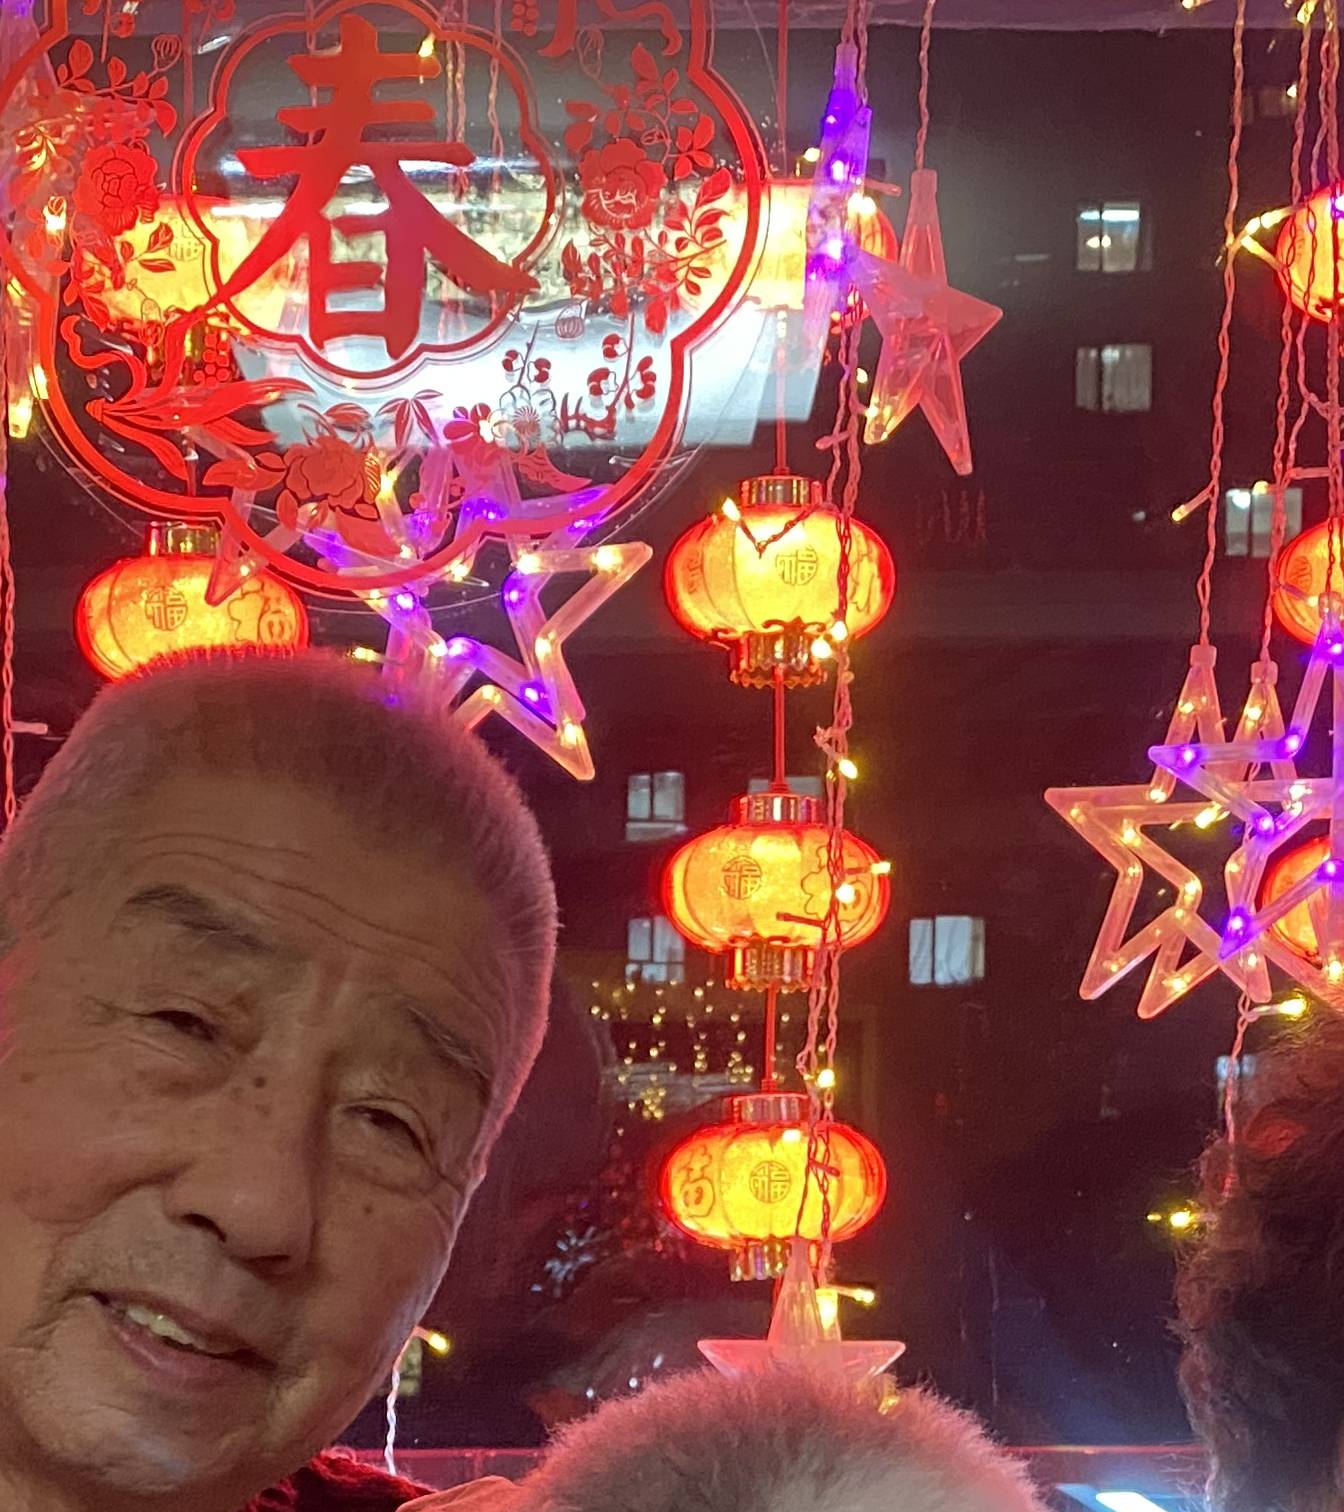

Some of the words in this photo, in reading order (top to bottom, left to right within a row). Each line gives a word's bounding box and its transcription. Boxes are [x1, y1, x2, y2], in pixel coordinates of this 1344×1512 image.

[219, 15, 540, 360] 春
[145, 586, 188, 632] 福
[722, 855, 763, 900] 福
[749, 1160, 792, 1204] 福
